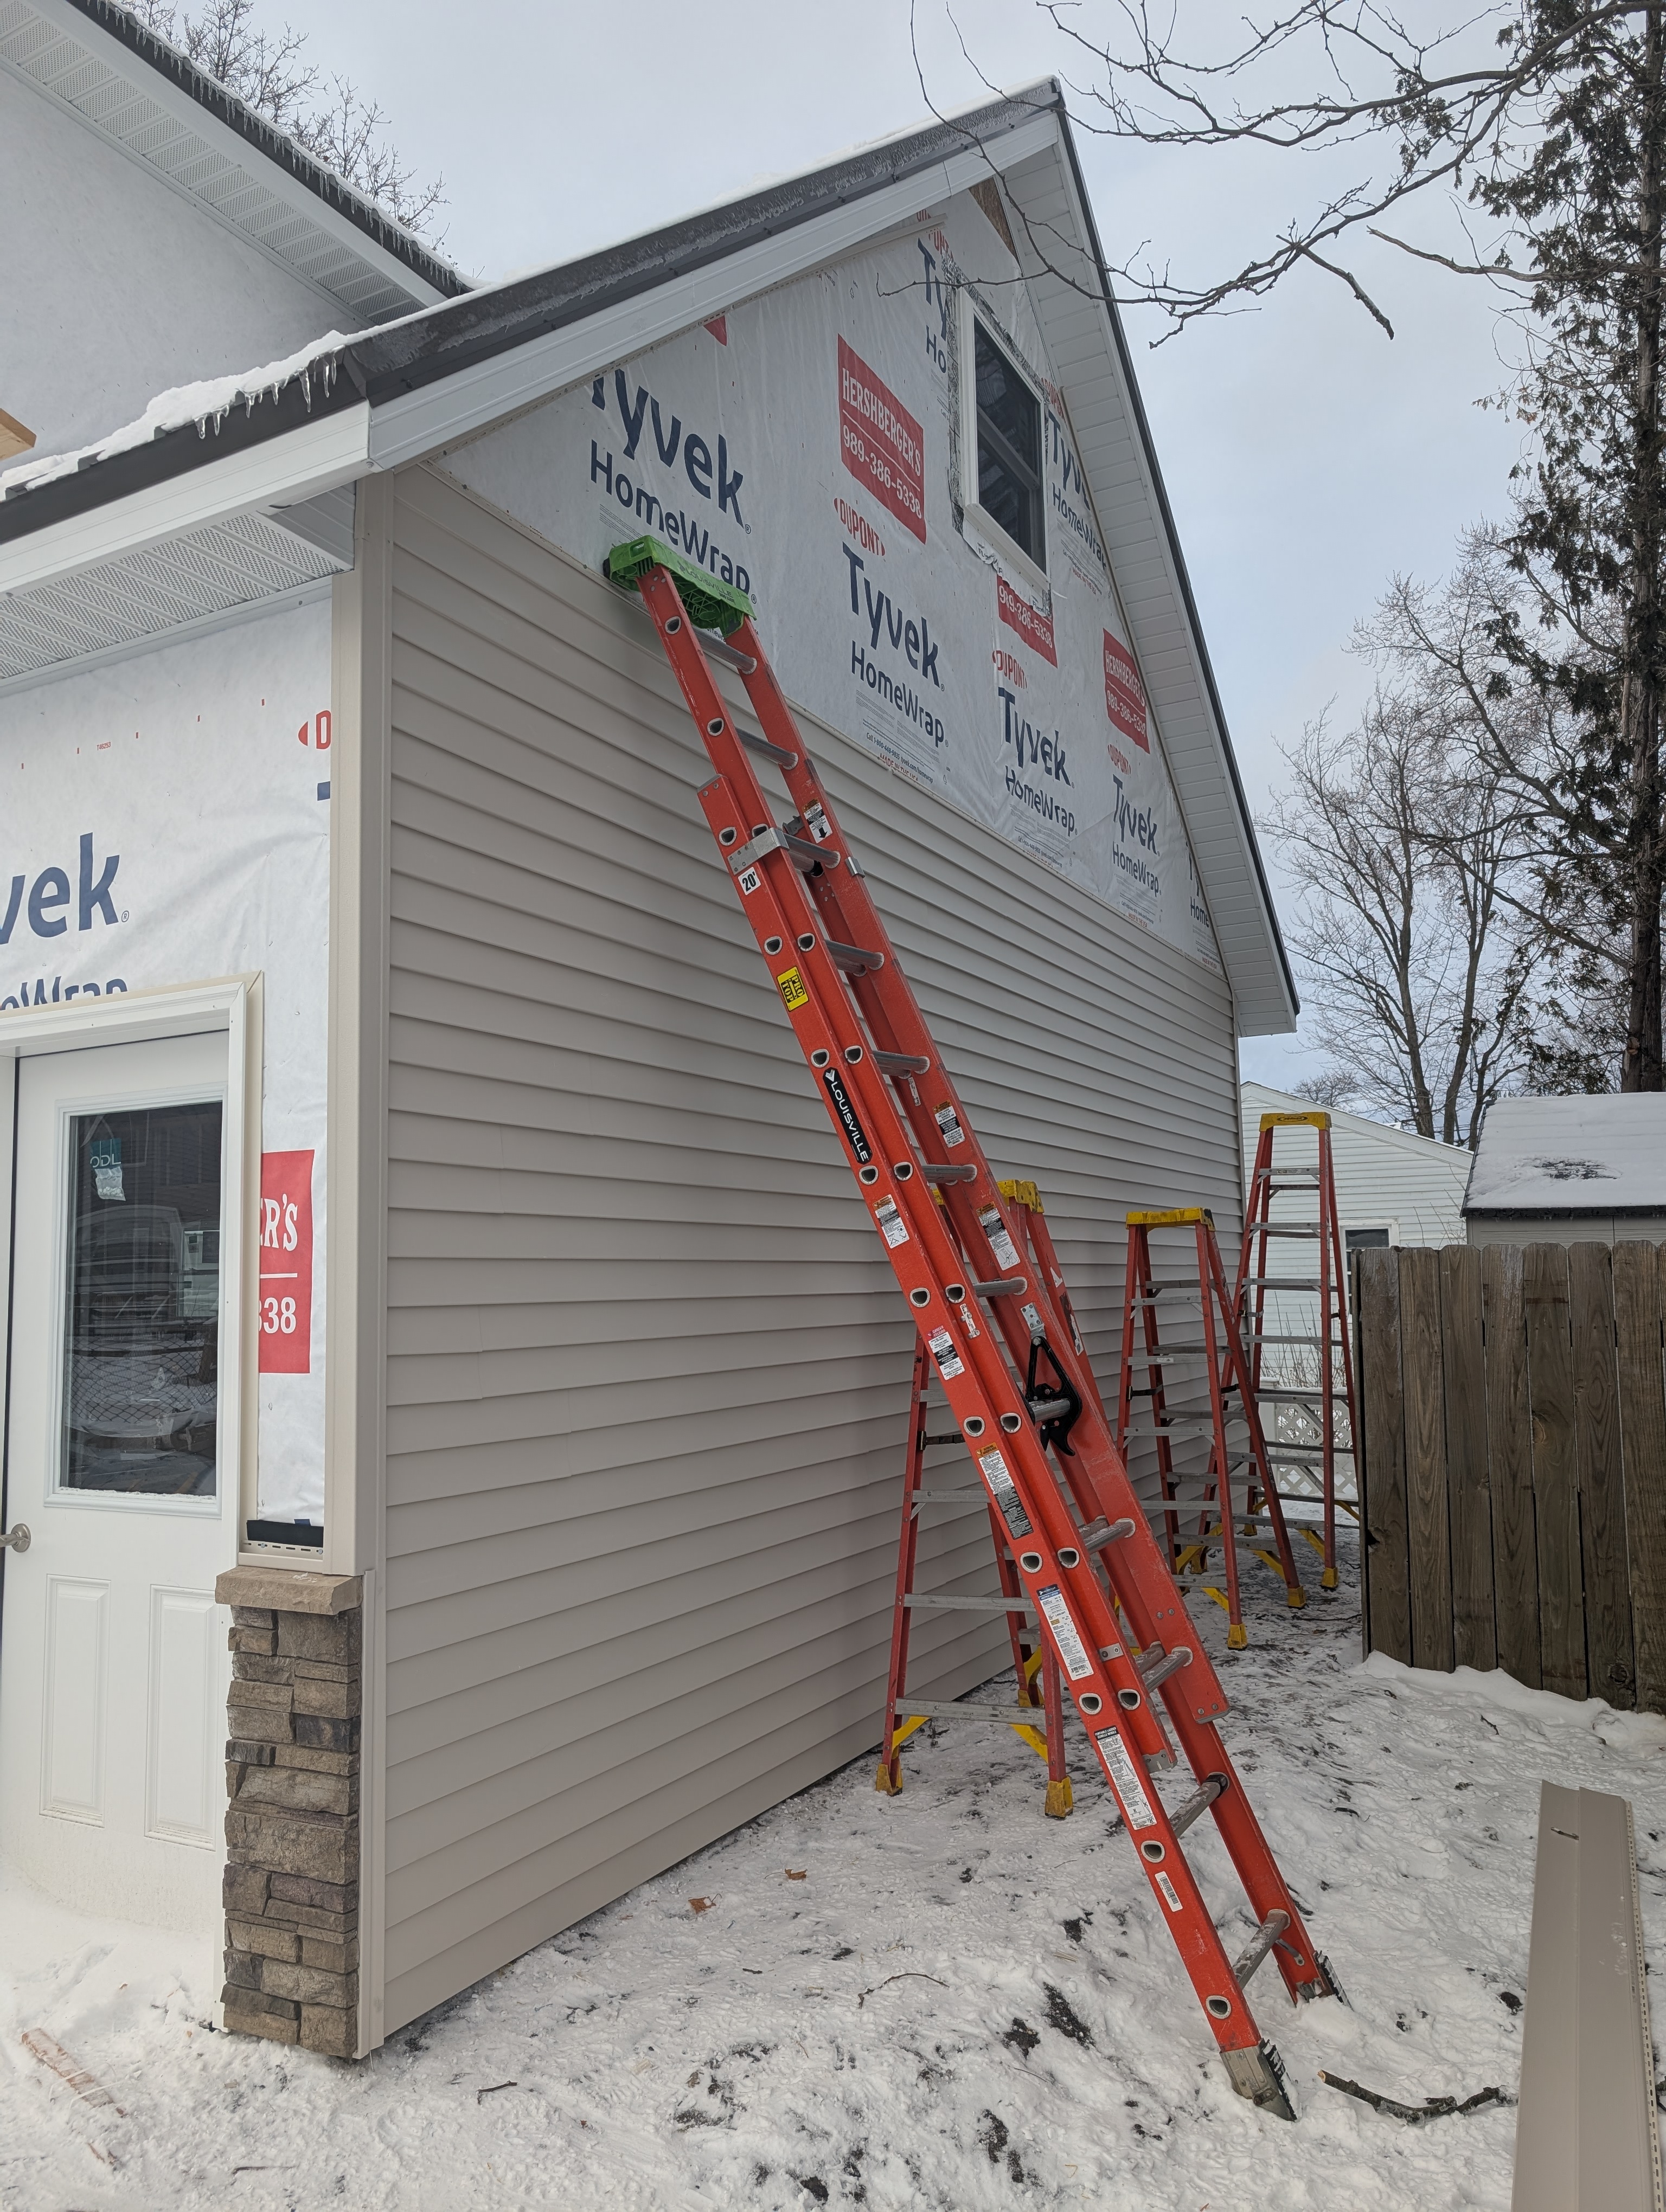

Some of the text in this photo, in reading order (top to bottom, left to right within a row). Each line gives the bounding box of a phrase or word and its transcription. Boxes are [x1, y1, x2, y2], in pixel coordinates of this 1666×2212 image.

[842, 368, 921, 477] HERSHBERGER'S
[843, 425, 922, 519] 989-386-5338
[840, 498, 880, 556] DUPONT
[685, 567, 731, 596] LOUISVILLE
[842, 541, 939, 688] Tyvek
[852, 640, 944, 748] HomeWrap
[996, 650, 1024, 690] DUPONT
[998, 687, 1071, 786] Tyvek
[1005, 765, 1075, 837] HomeWrap
[1113, 774, 1157, 855] Tyvek
[1112, 841, 1159, 898] HomeWrap
[781, 980, 794, 1002] TOP
[791, 974, 805, 998] PRO
[831, 1082, 869, 1162] LOUISVILLE
[90, 1154, 121, 1168] ODL
[260, 1193, 298, 1251] R'S
[260, 1297, 296, 1334] 38
